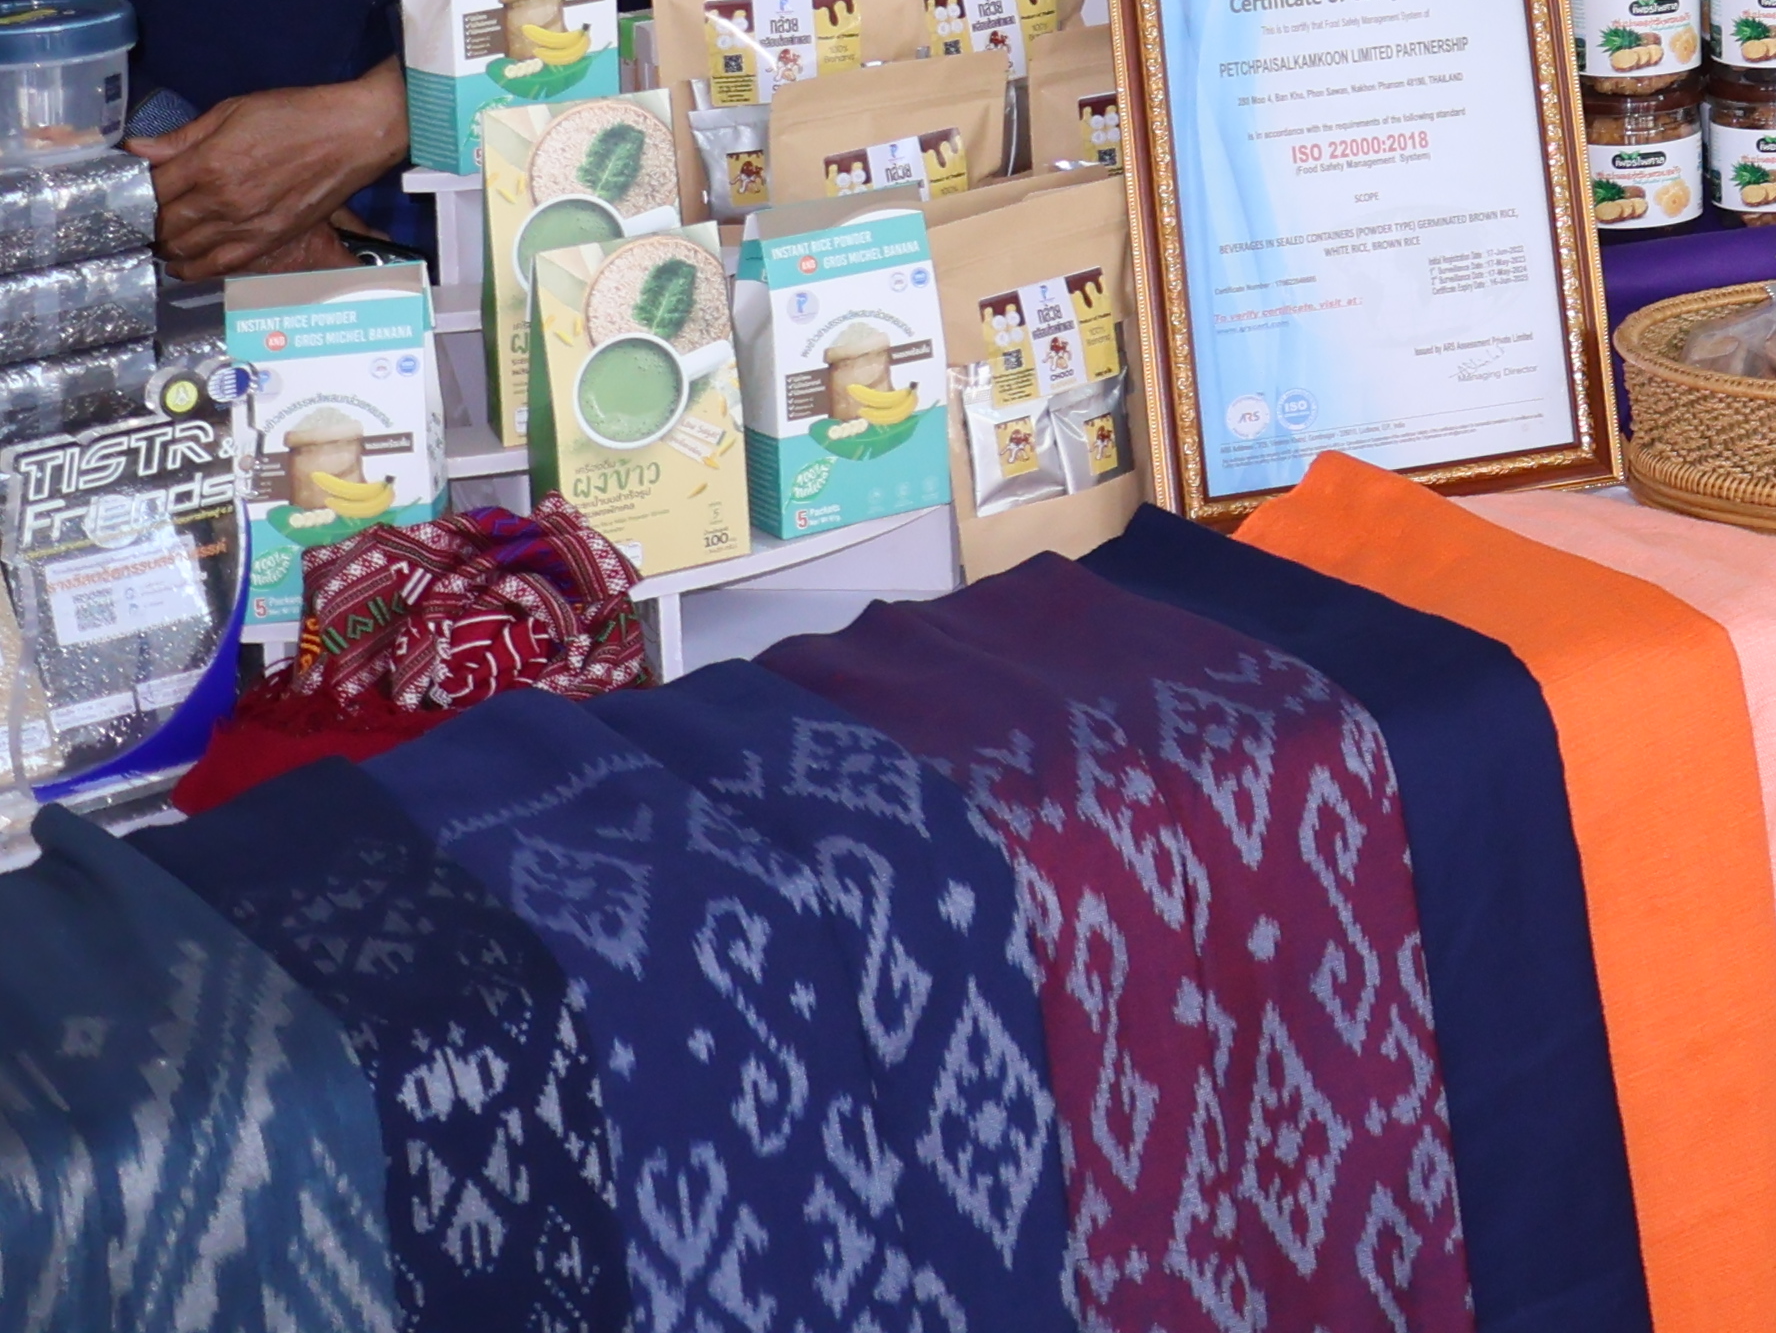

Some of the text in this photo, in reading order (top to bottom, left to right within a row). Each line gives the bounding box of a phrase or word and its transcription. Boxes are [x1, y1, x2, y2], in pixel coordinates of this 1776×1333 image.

[770, 15, 799, 35] กล้วย
[1324, 18, 1340, 30] Food
[1341, 16, 1361, 30] Safety
[1219, 36, 1470, 79] PETCHPAISALKAMKOON LIMITED PARTNERSHIP
[1428, 71, 1465, 85] THAILAND
[1264, 126, 1305, 140] accordance
[1306, 123, 1322, 135] with
[1334, 117, 1381, 133] requirements
[1403, 110, 1435, 124] following
[1435, 106, 1467, 120] standard
[1290, 130, 1430, 165] ISO 22000:2018
[1295, 151, 1432, 177] (Food Safety Management System)
[1353, 190, 1381, 205] SCOPE
[1218, 237, 1265, 256] BEVERAGES
[1275, 232, 1304, 247] SEALED
[1305, 227, 1355, 244] CONTAINERS
[1355, 222, 1393, 240] (POWDER
[1394, 219, 1416, 235] TYPE)
[1416, 212, 1467, 230] GERMINATED
[1467, 209, 1499, 224] BROWN
[771, 230, 873, 260] INSTANT RICE POWDER
[823, 253, 848, 269] GROS
[883, 240, 921, 258] BANANA
[1323, 243, 1350, 258] WHITE
[1371, 237, 1403, 252] BROWN
[1403, 234, 1422, 249] RICE
[236, 310, 358, 333] INSTANT RICE POWDER
[294, 333, 325, 348] GROS
[326, 328, 367, 345] MICHEL
[368, 325, 413, 341] BANANA
[1503, 364, 1539, 377] Director
[1283, 399, 1308, 413] ISO
[19, 419, 238, 502] TISTR &
[572, 458, 661, 499] ผงข้าว
[21, 471, 236, 549] Friends
[795, 509, 809, 530] 5
[703, 532, 729, 549] 100
[253, 596, 267, 619] 5
